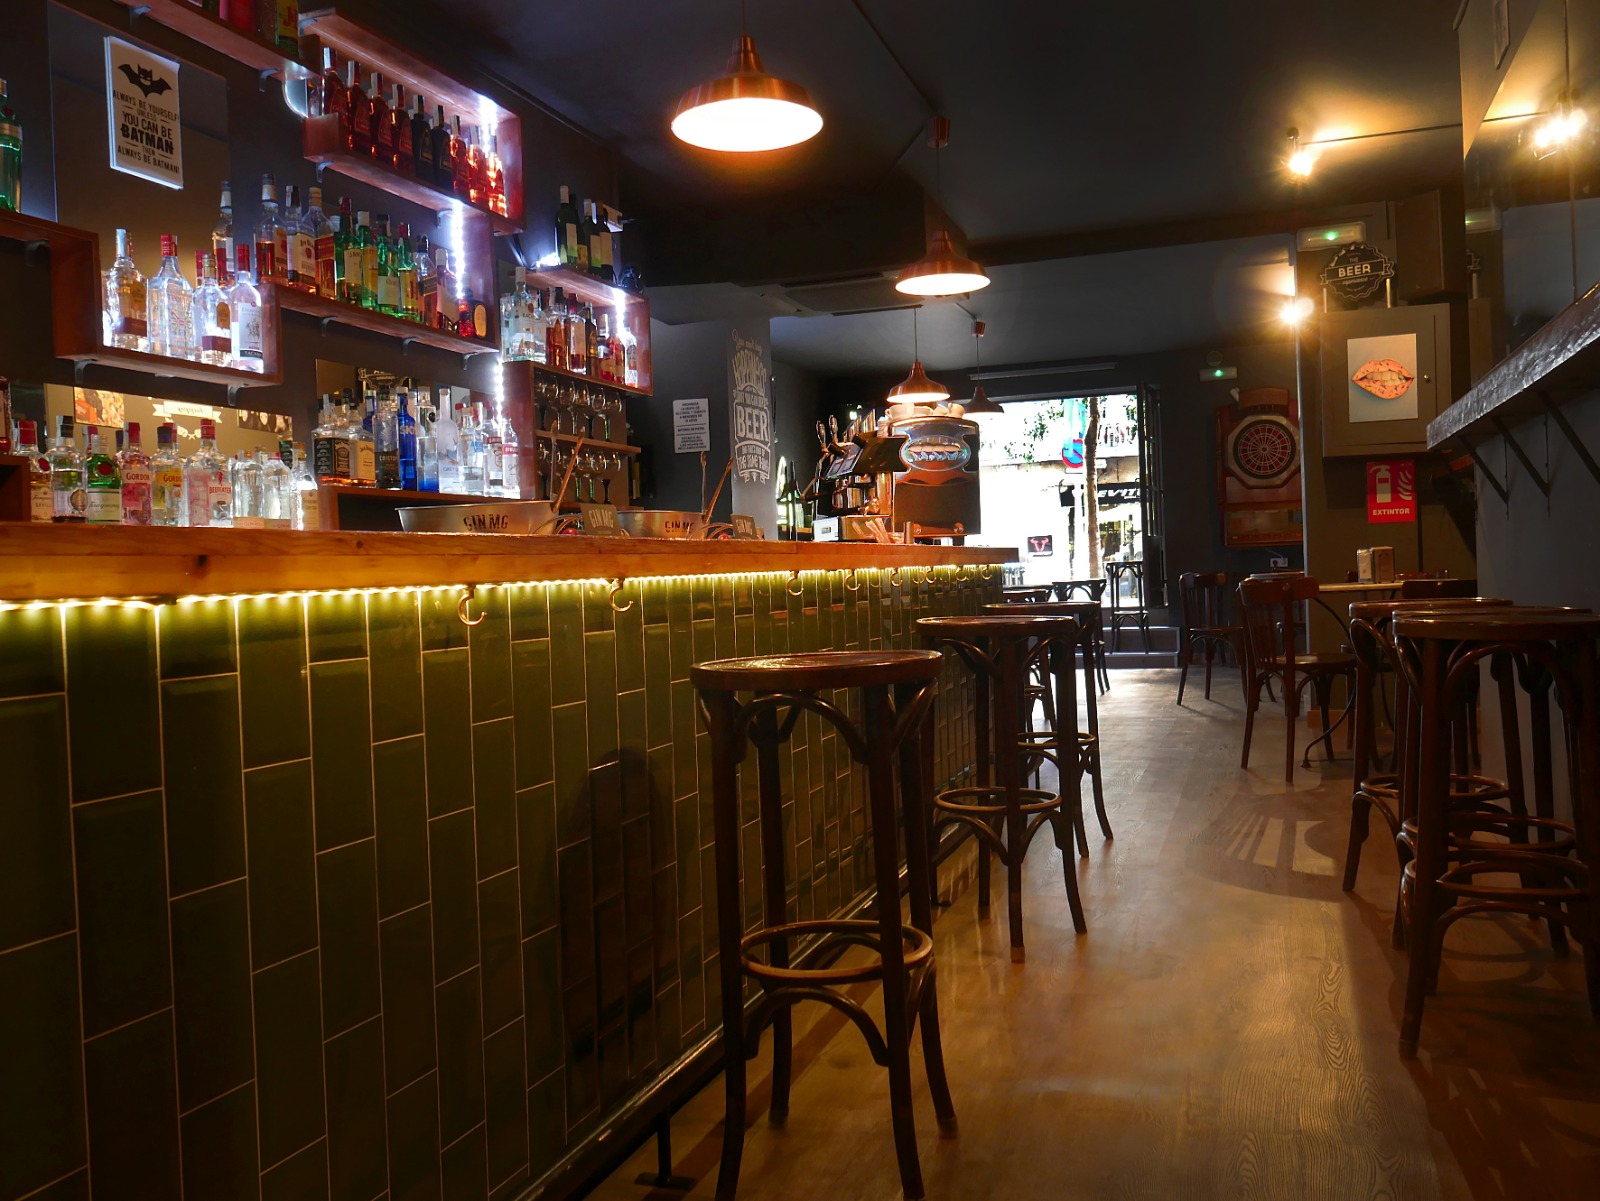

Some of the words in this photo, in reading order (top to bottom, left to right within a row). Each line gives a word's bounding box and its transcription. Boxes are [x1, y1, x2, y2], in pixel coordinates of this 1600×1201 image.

[113, 90, 136, 106] ALWAYS
[138, 99, 147, 110] BE
[136, 108, 157, 122] UNLESS
[122, 110, 139, 127] YOU
[141, 118, 159, 135] CAN
[161, 125, 173, 140] BE
[120, 123, 174, 155] BATMAN
[117, 145, 141, 161] ALWAYS
[143, 154, 151, 164] BE
[142, 145, 156, 156] THEN
[1338, 263, 1372, 278] BEER
[735, 405, 769, 442] BEER
[588, 509, 602, 528] GIN
[602, 509, 614, 528] MG
[1372, 508, 1410, 516] EXTINTOR
[463, 514, 486, 531] GIN
[489, 513, 509, 530] MG
[664, 520, 681, 533] GIN
